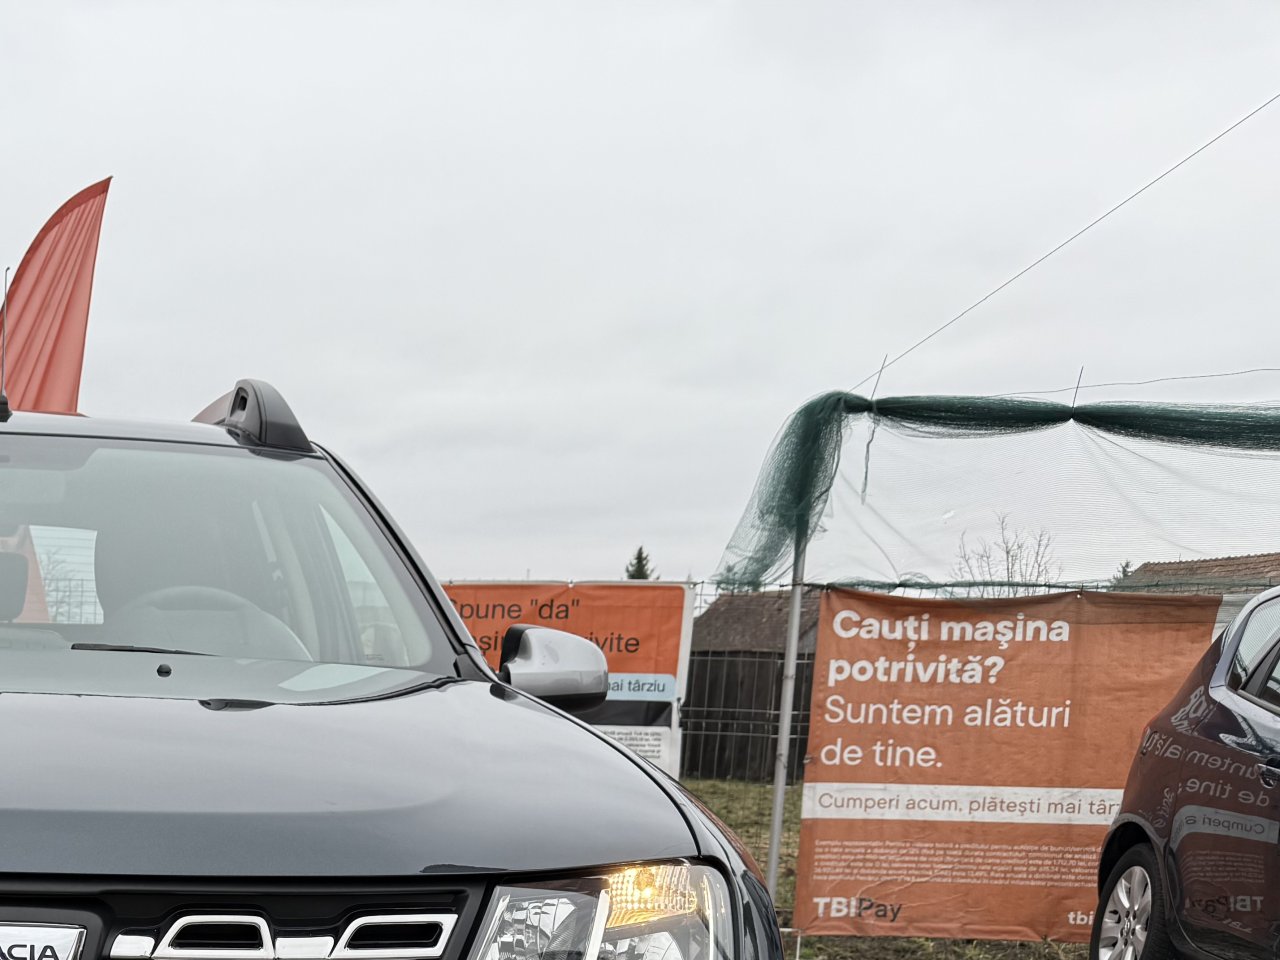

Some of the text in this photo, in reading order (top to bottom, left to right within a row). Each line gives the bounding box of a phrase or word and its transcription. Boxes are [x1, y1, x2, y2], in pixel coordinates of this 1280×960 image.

[530, 598, 580, 620] "da"
[833, 609, 930, 651] Cauți
[827, 653, 1005, 687] potrivită?
[628, 680, 666, 693] târziu
[824, 695, 1071, 728] Suntem alături
[820, 738, 943, 767] de tine.
[818, 792, 900, 815] Cumperi
[1047, 799, 1081, 815] mai
[812, 897, 903, 922] TBIPay
